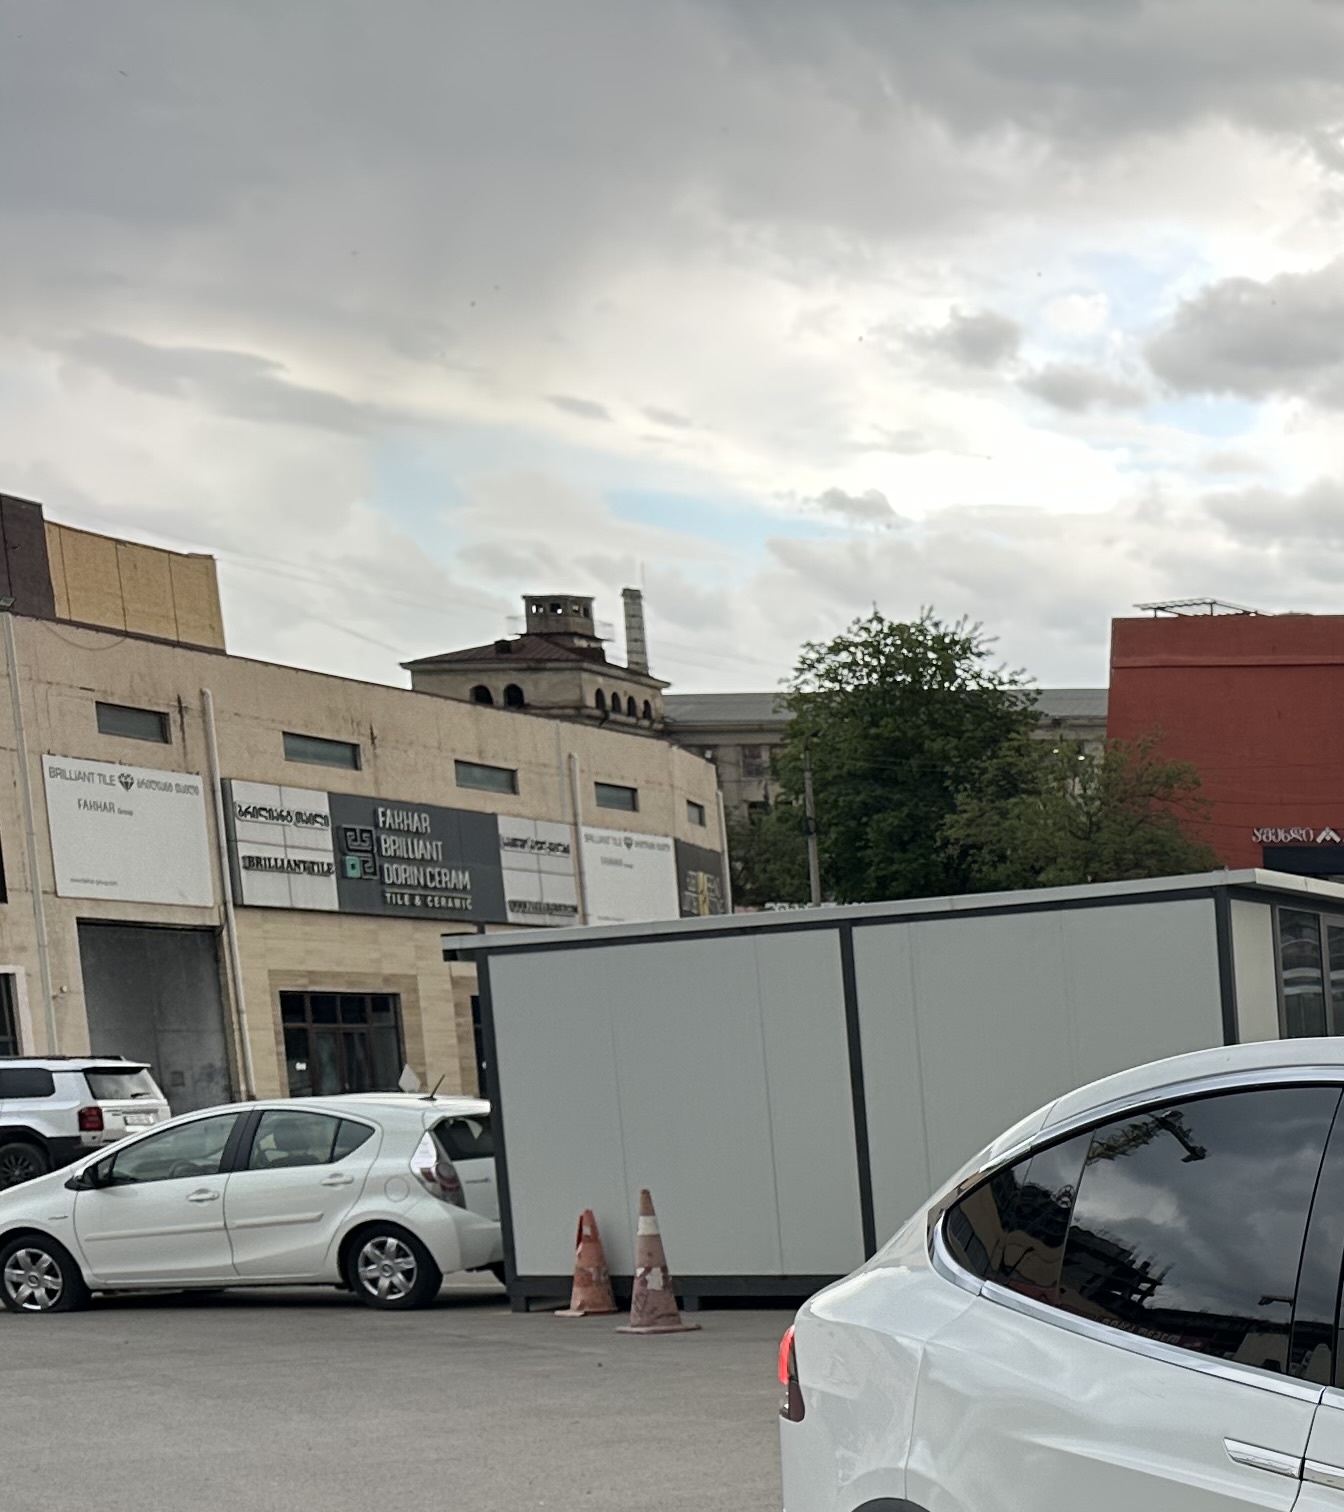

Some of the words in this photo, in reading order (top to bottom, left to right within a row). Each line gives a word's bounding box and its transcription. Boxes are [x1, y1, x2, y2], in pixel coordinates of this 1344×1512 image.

[96, 772, 116, 787] TILE
[380, 834, 443, 862] BRILLIANT
[246, 856, 307, 873] BRILLIANT
[309, 861, 335, 876] TILE
[383, 863, 425, 887] DORIN
[426, 865, 471, 891] CERAM
[385, 892, 411, 906] TILE
[426, 894, 474, 911] CERAMIC
